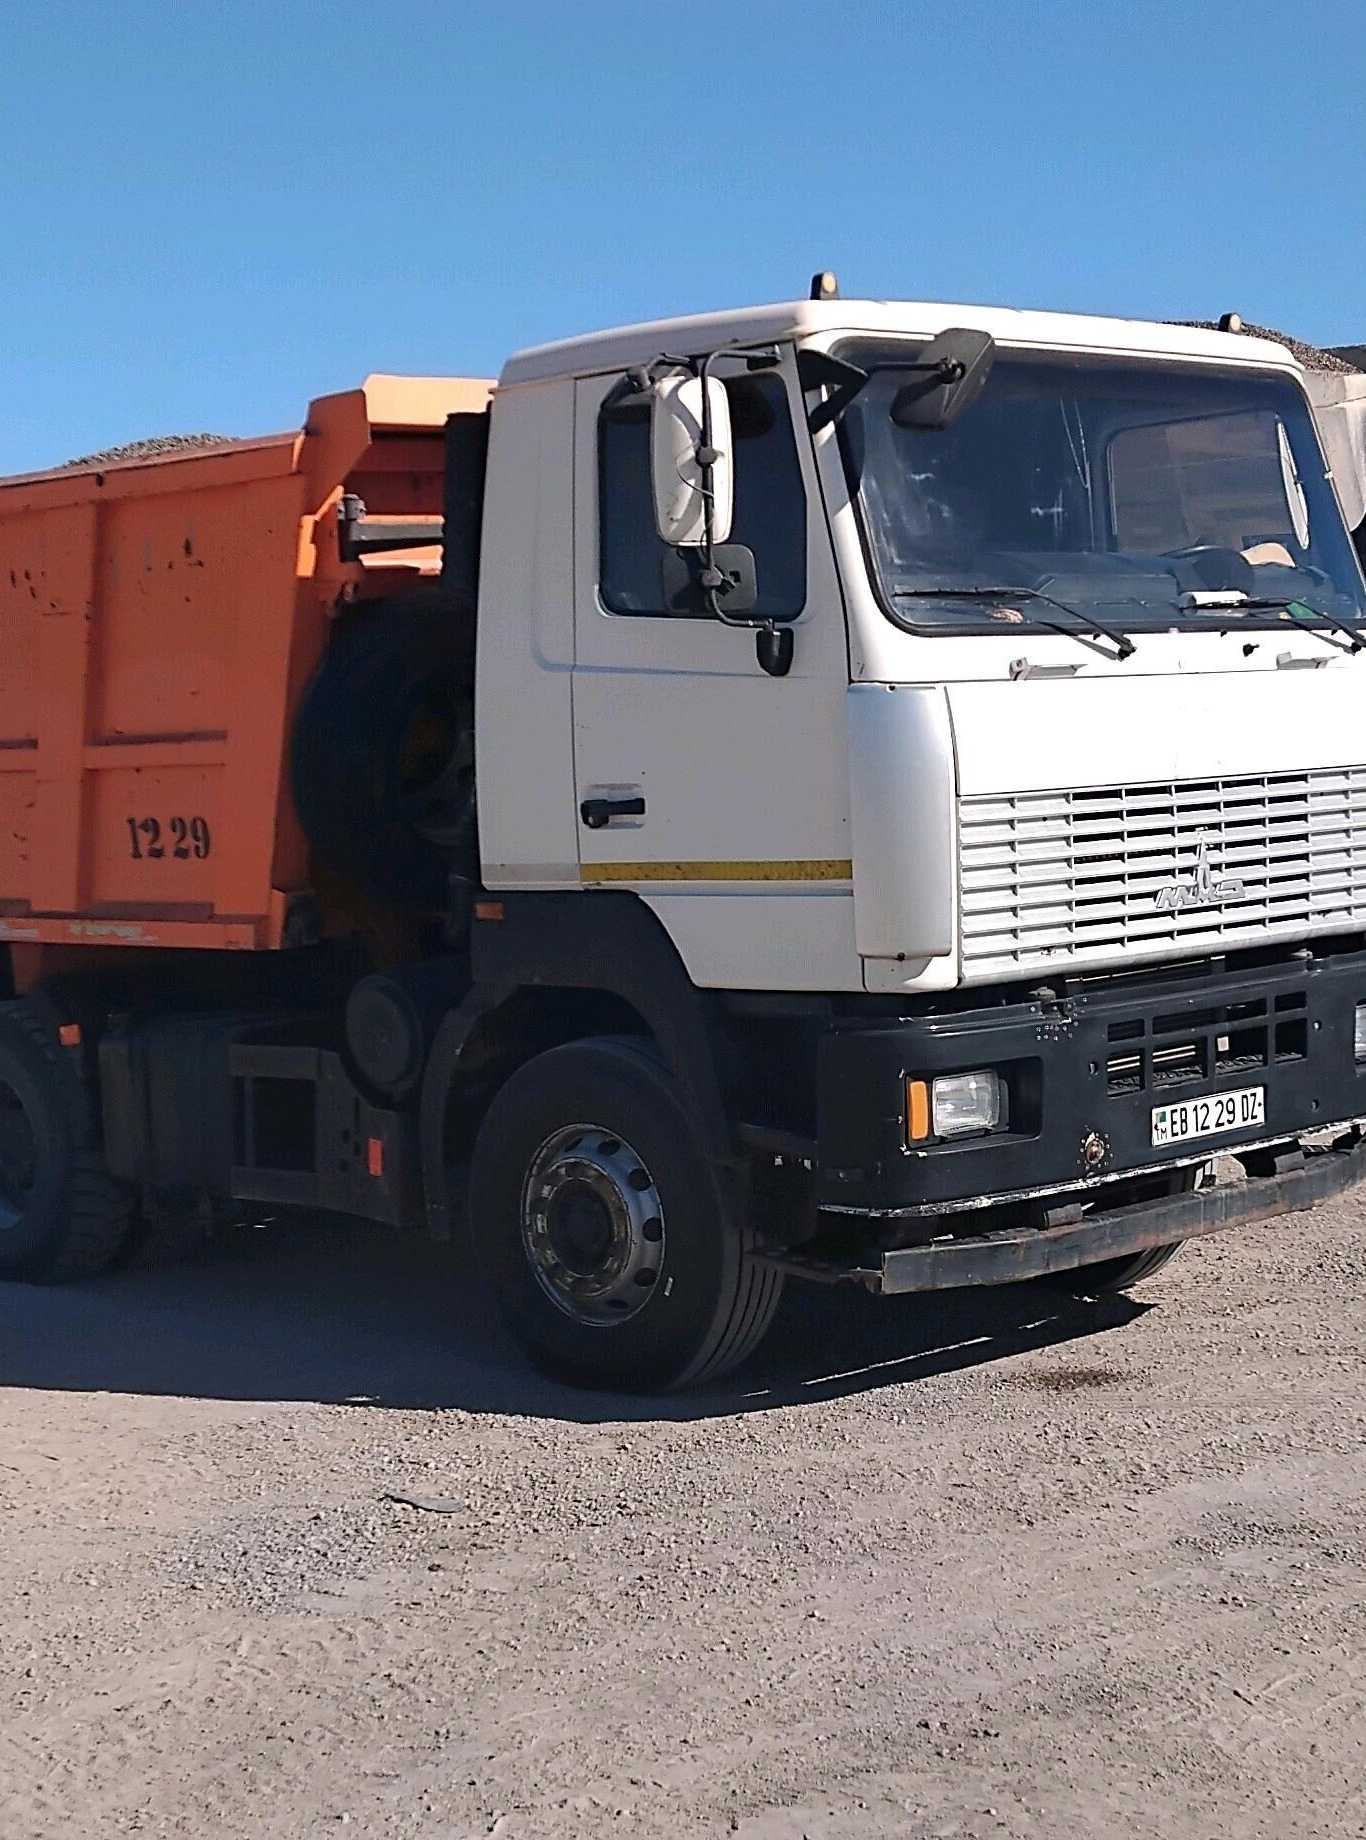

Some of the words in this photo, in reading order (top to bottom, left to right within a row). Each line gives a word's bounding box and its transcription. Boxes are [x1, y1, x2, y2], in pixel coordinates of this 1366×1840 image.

[126, 816, 165, 859] 12
[170, 816, 210, 860] 29
[1170, 1107, 1188, 1138] EB
[1192, 1102, 1210, 1133] 12
[1214, 1097, 1236, 1128] 29
[1241, 1092, 1258, 1122] DZ
